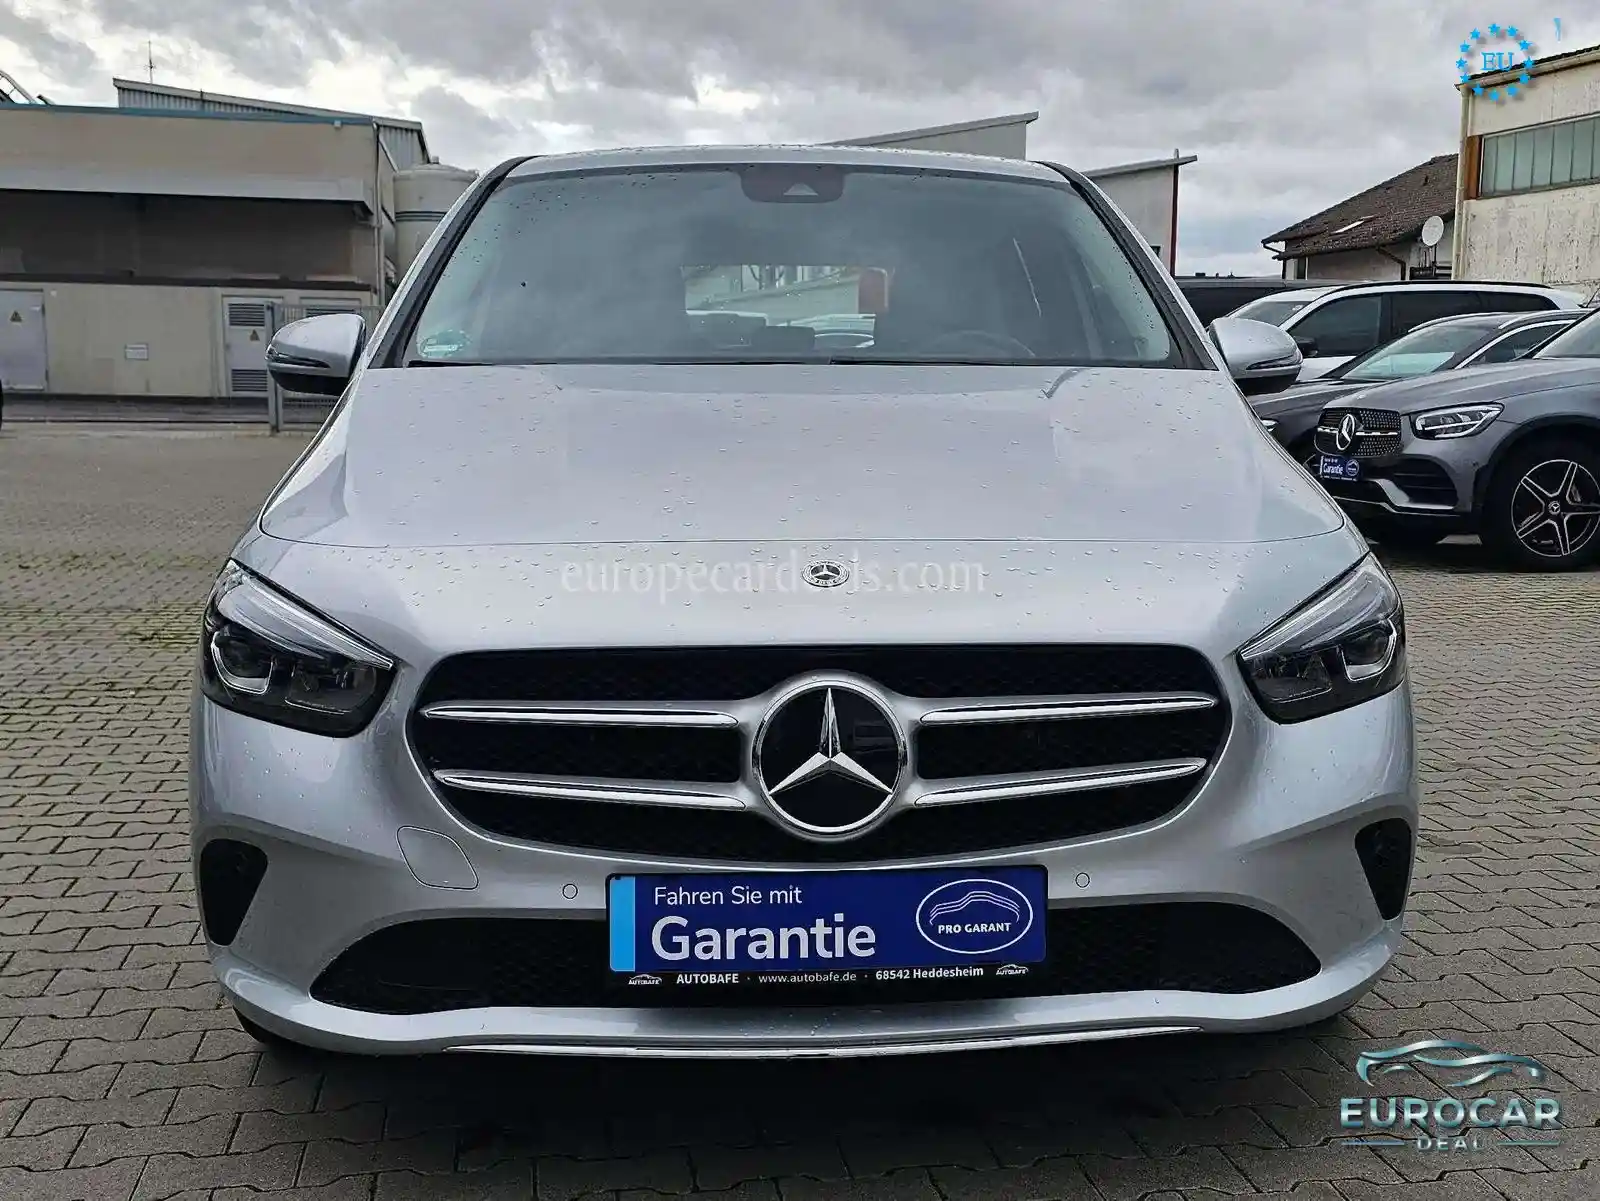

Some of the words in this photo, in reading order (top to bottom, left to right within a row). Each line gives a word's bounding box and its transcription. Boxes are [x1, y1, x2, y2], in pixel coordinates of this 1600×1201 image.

[654, 886, 724, 906] Fahren
[731, 885, 763, 905] Sie
[769, 884, 803, 905] mit
[651, 912, 877, 961] Garantie
[937, 923, 962, 934] PRO
[964, 922, 1012, 933] GARANT
[676, 973, 739, 985] AUTOBAFE
[758, 971, 857, 984] www.autobafe.de
[875, 970, 910, 981] 68542
[913, 966, 984, 979] Heddesheim
